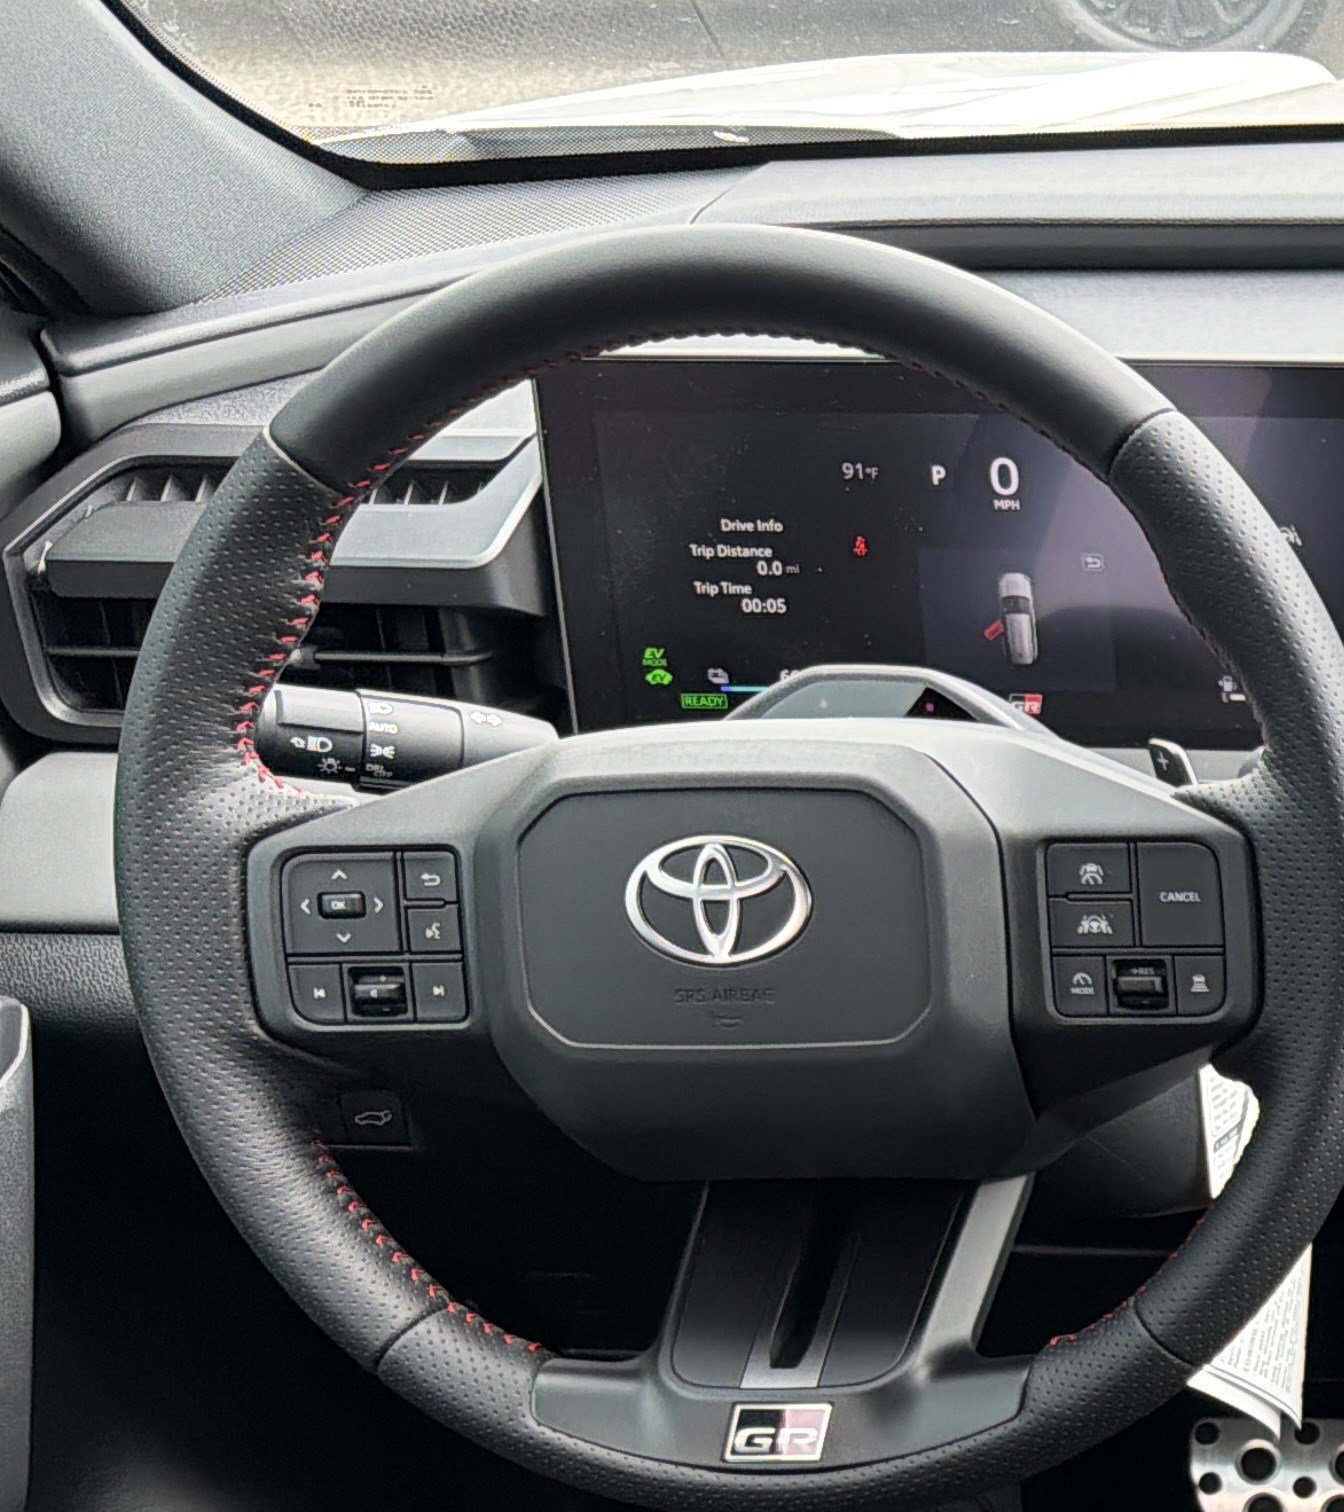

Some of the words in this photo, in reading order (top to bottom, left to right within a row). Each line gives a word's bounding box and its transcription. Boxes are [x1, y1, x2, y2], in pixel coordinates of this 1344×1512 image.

[931, 465, 946, 486] P
[990, 457, 1019, 496] 0
[993, 499, 1020, 511] MPH
[720, 518, 754, 532] Drive
[757, 518, 784, 532] Info
[689, 543, 714, 559] Trip
[717, 543, 773, 557] Distance
[756, 560, 783, 576] 0.0
[693, 581, 719, 597] Trip
[720, 581, 752, 595] Time
[741, 598, 787, 613] 00:05
[644, 648, 665, 659] EV
[684, 696, 724, 706] READY
[1160, 891, 1201, 903] CANCEL
[734, 1427, 819, 1454] GR
